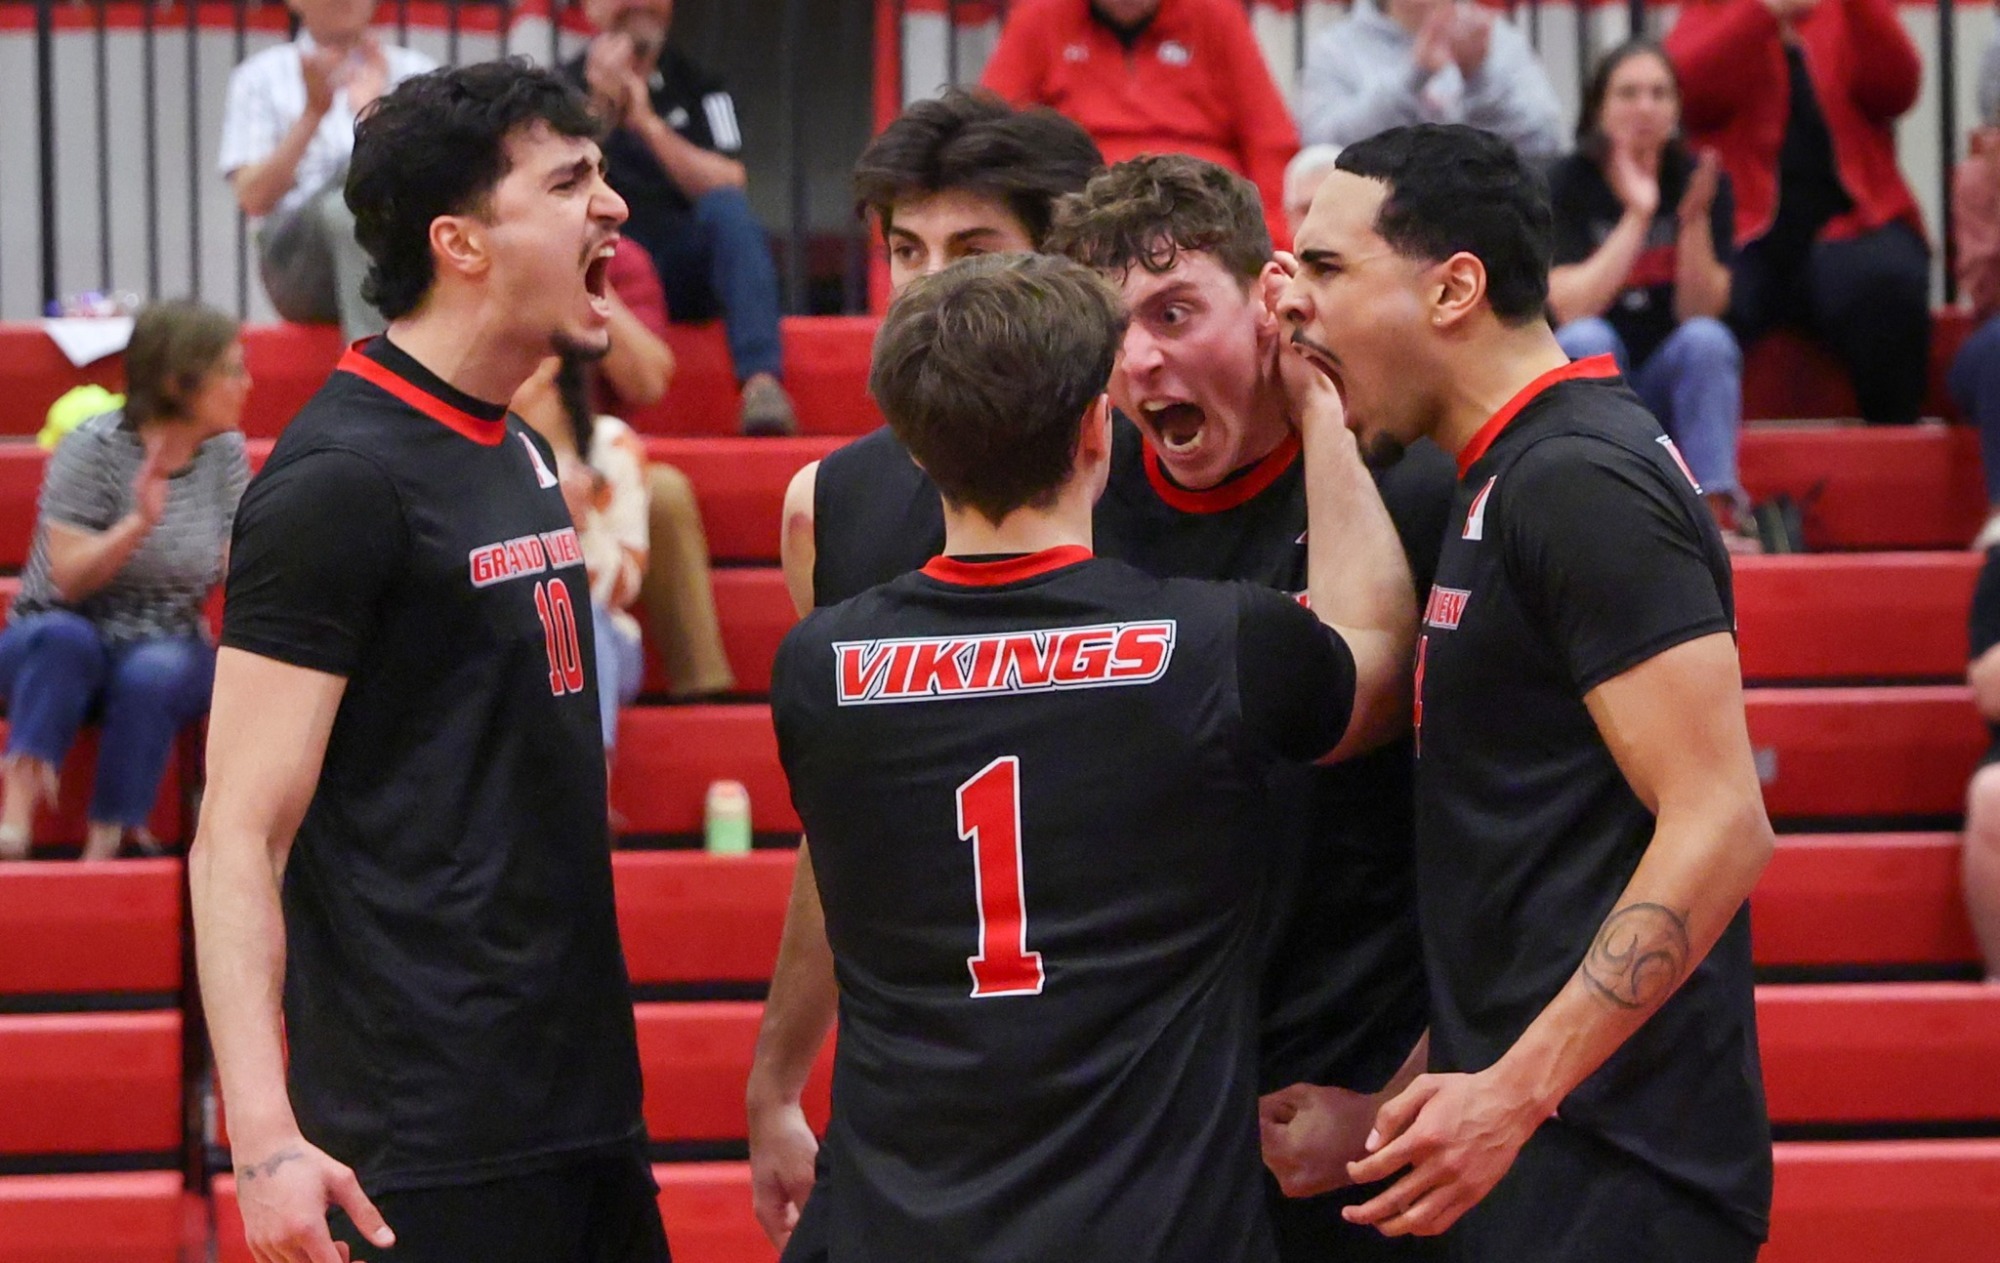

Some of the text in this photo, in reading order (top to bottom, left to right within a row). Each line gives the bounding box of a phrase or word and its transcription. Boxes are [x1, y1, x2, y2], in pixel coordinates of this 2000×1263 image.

[470, 535, 546, 587] GRAND
[534, 578, 584, 696] 10
[832, 619, 1176, 706] VIKINGS
[955, 755, 1045, 998] 1
